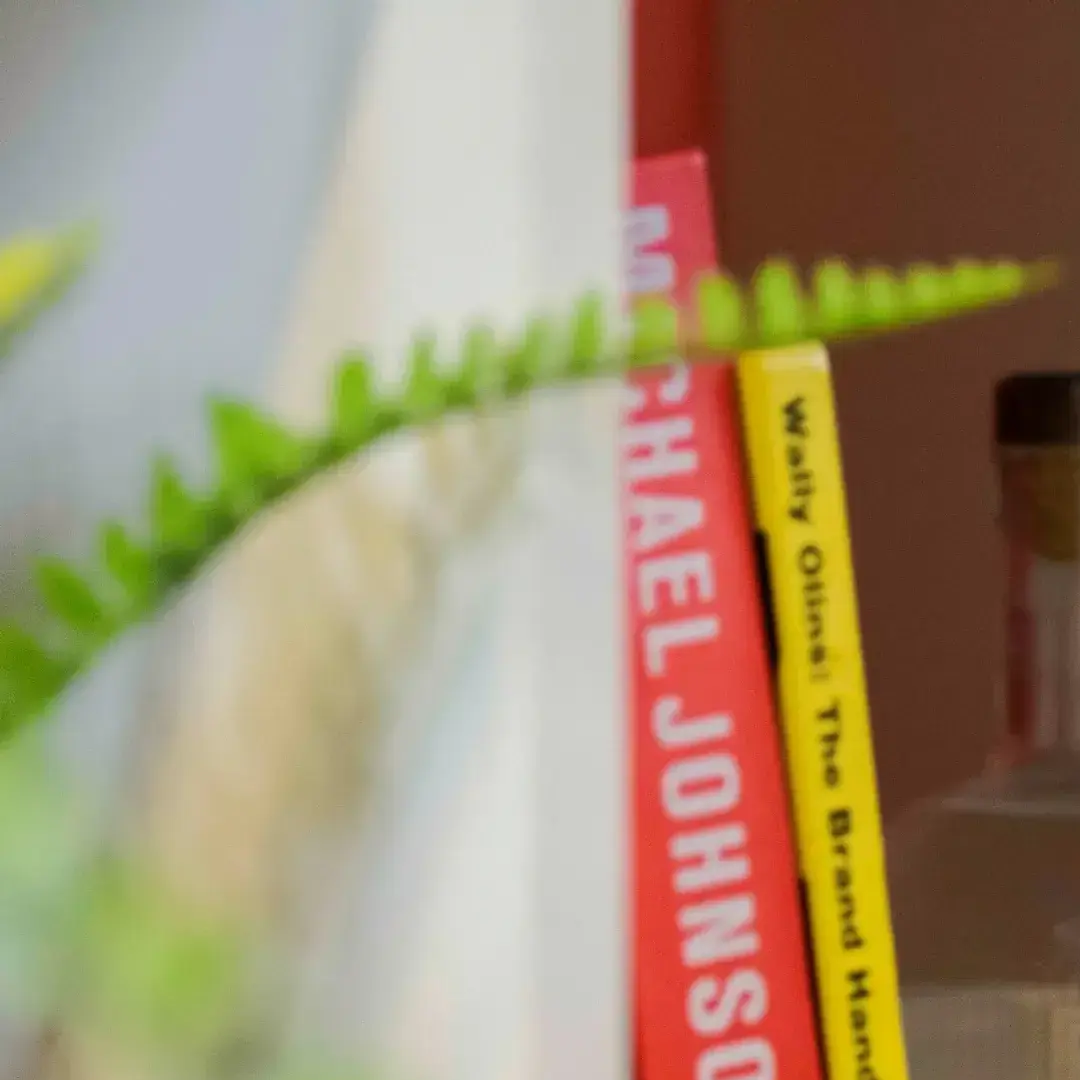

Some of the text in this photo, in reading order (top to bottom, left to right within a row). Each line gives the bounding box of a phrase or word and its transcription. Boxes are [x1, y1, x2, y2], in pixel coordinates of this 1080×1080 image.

[782, 396, 816, 524] Wally
[814, 699, 842, 790] The
[826, 807, 866, 952] Brand
